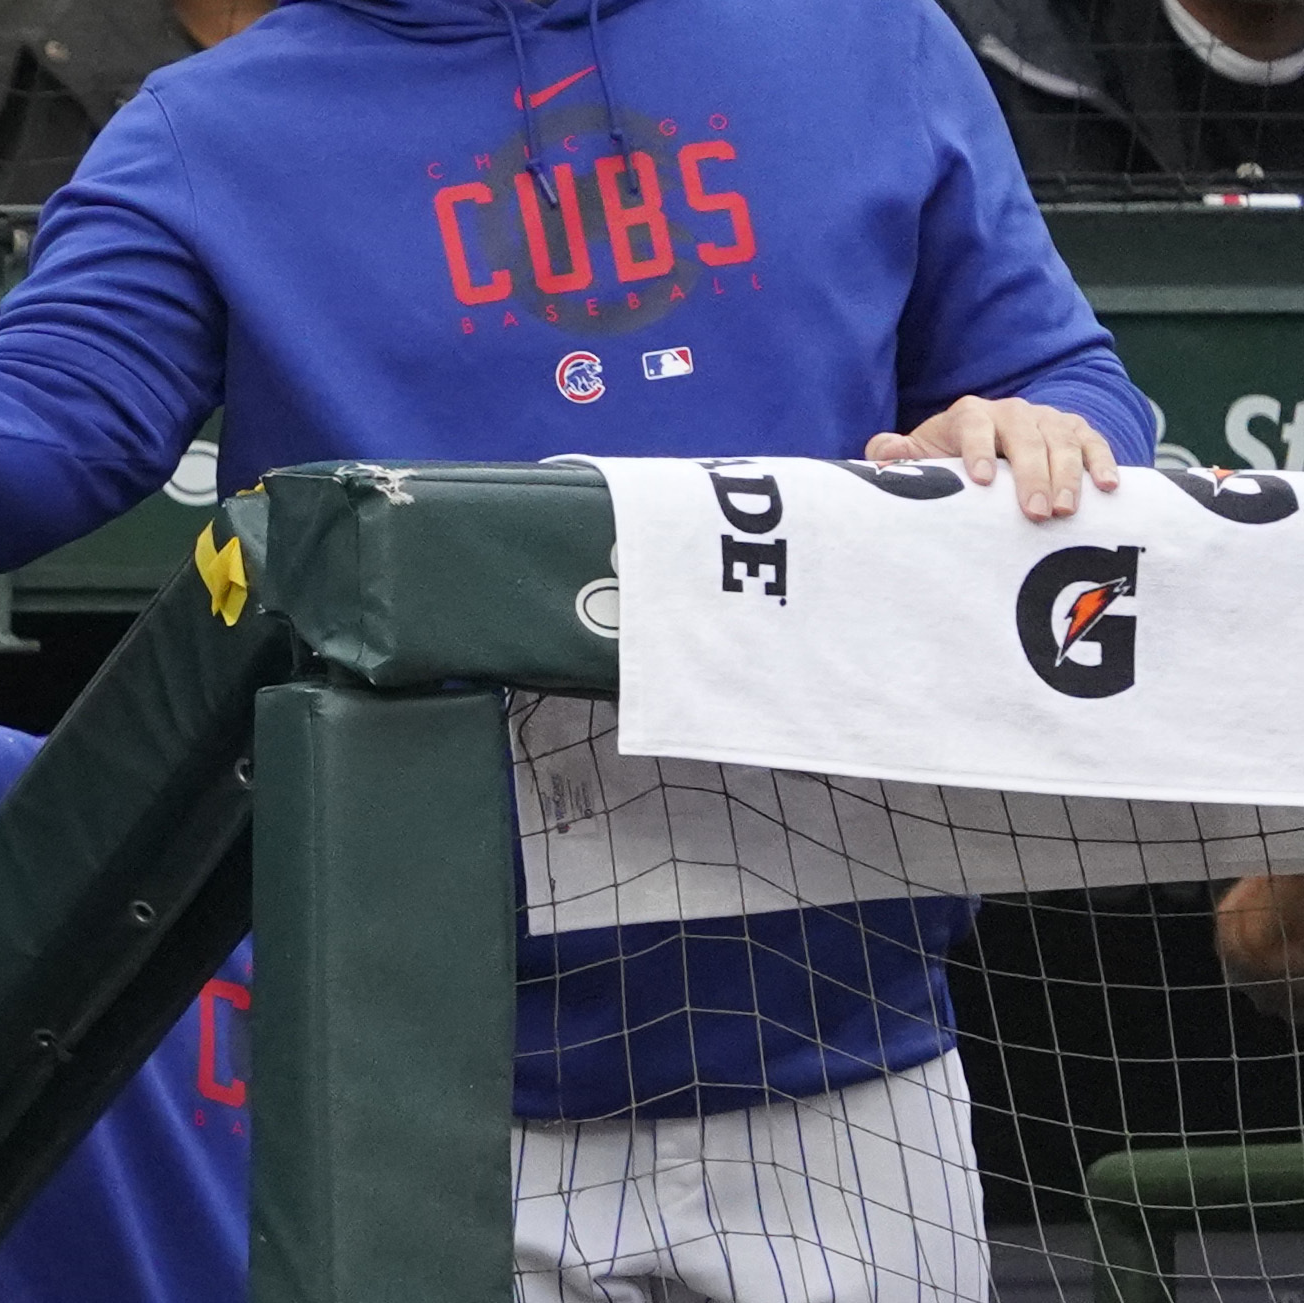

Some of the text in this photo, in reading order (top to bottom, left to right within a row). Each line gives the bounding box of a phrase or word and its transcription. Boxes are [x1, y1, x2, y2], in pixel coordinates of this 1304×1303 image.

[427, 112, 729, 180] CHICGO
[433, 139, 757, 307] CUBS
[460, 272, 764, 335] BASEBALL
[696, 459, 787, 597] DE
[1016, 545, 1139, 699] G
